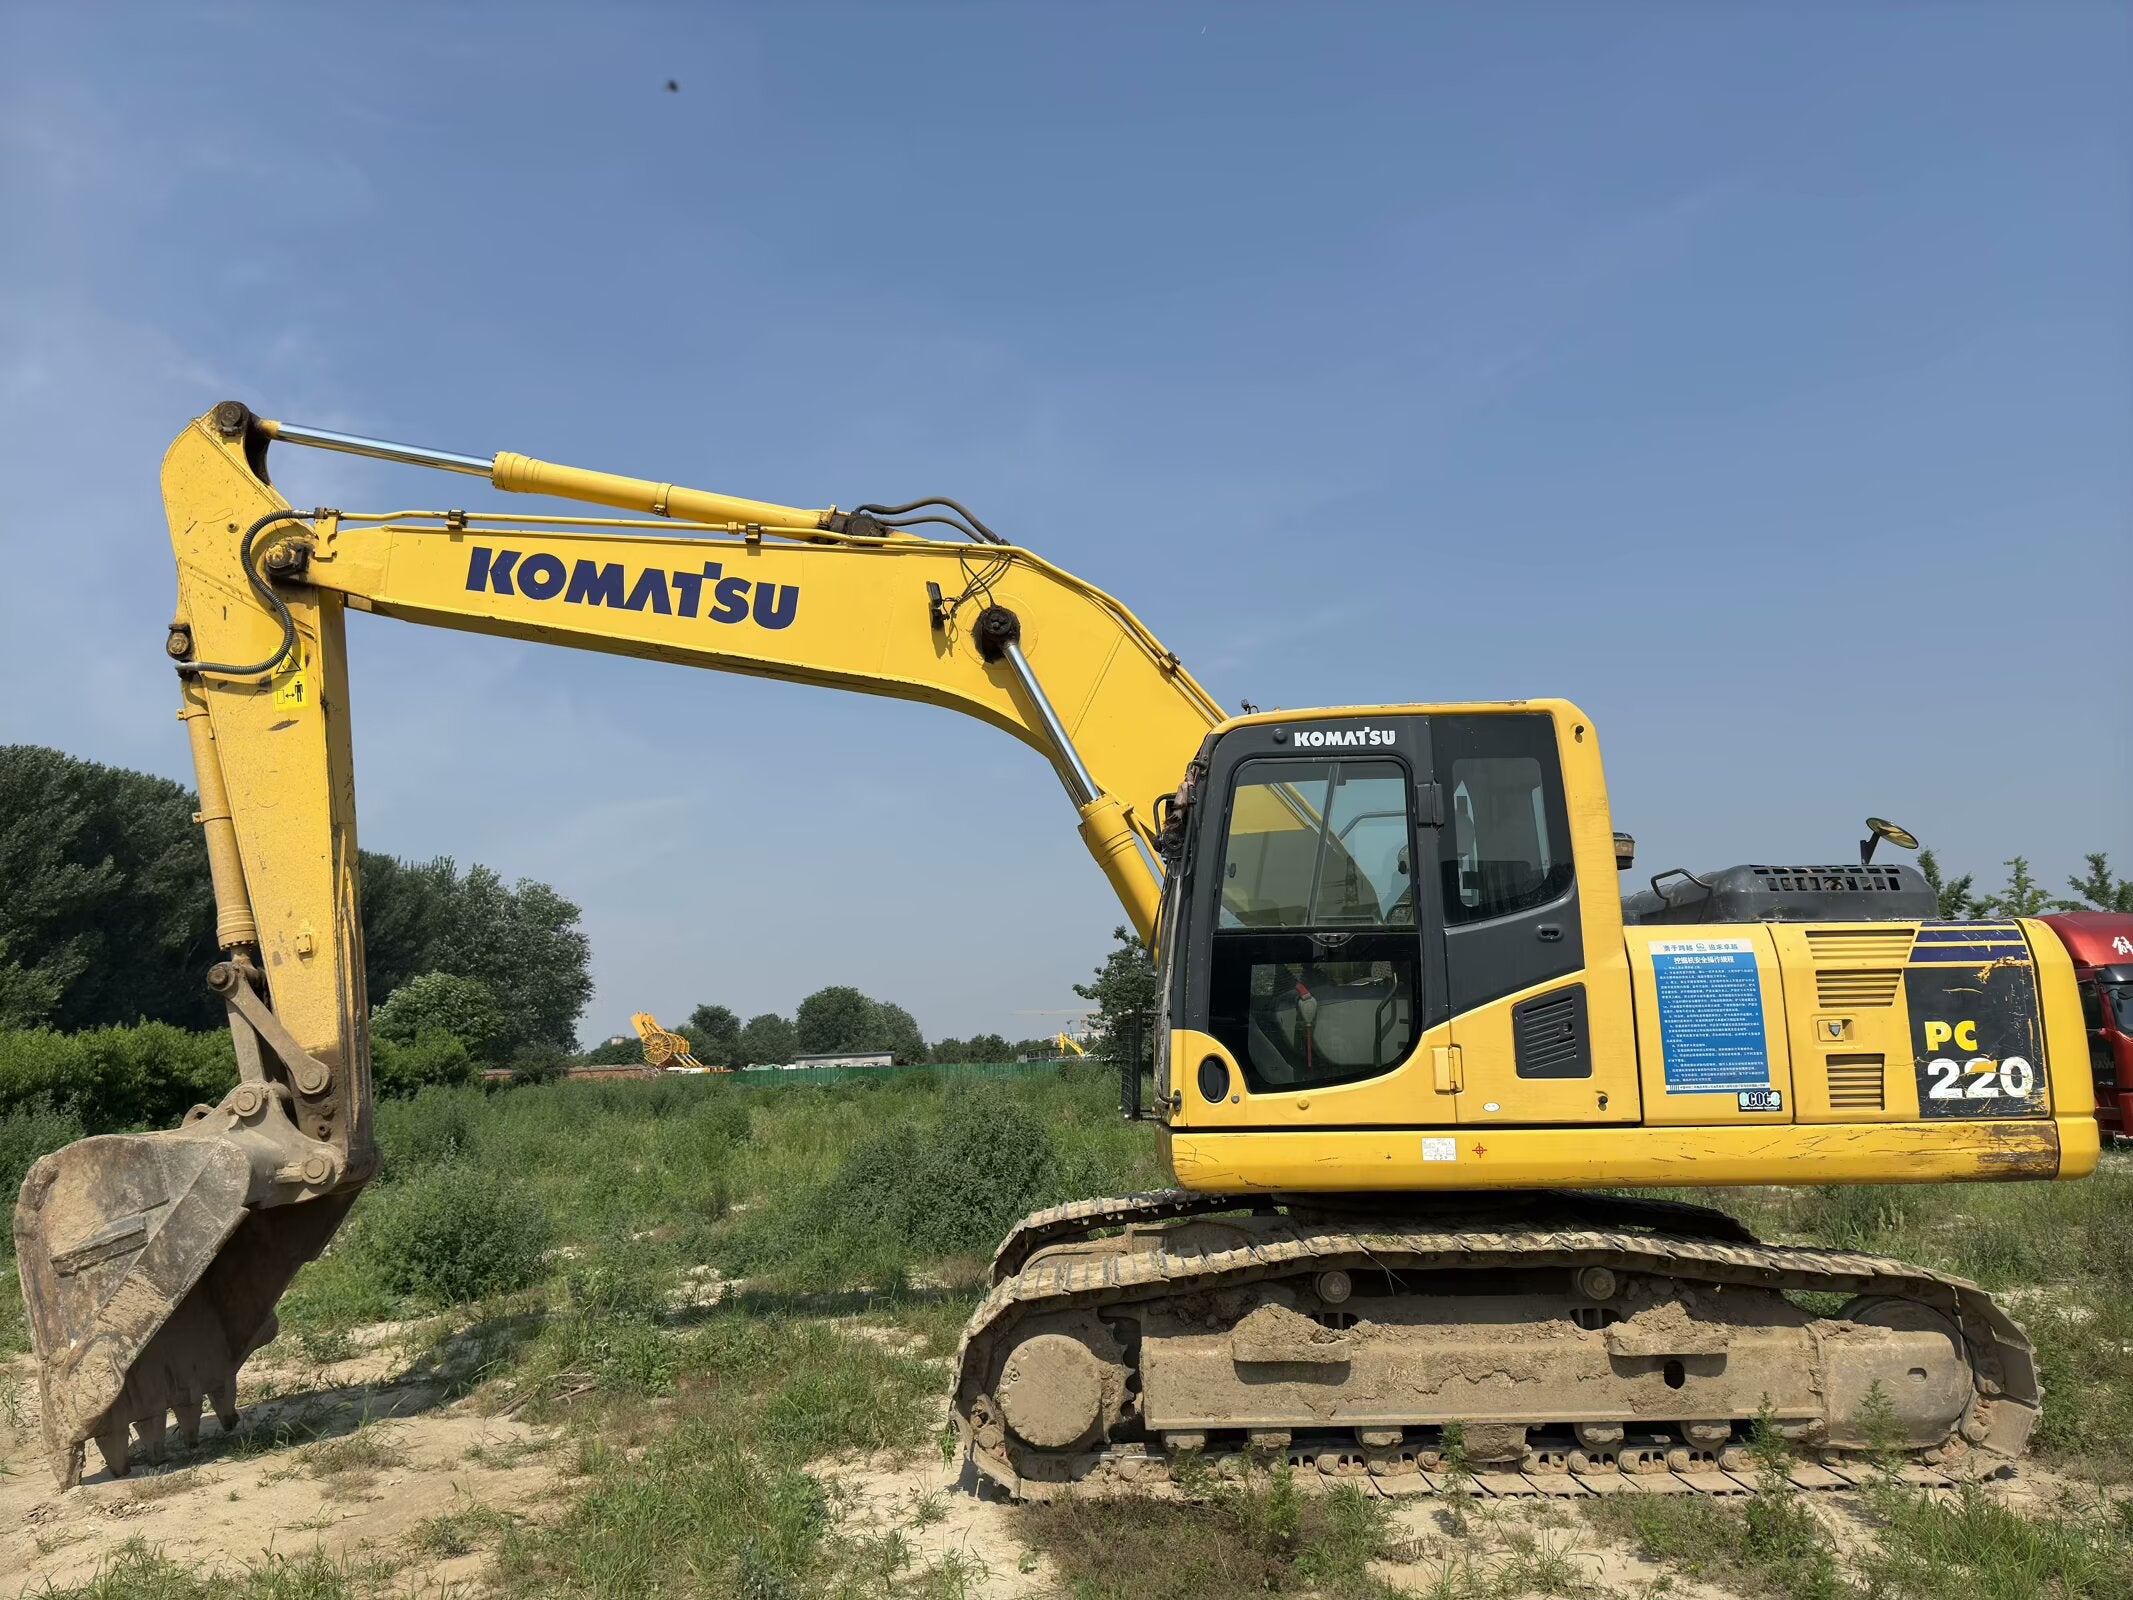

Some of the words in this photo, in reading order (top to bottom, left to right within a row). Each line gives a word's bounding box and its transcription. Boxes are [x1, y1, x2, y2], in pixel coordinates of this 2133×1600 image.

[465, 546, 800, 630] KOMATSU
[1294, 726, 1396, 747] KOMATSU
[1924, 1020, 1979, 1052] PC
[1927, 1056, 2034, 1099] 220
